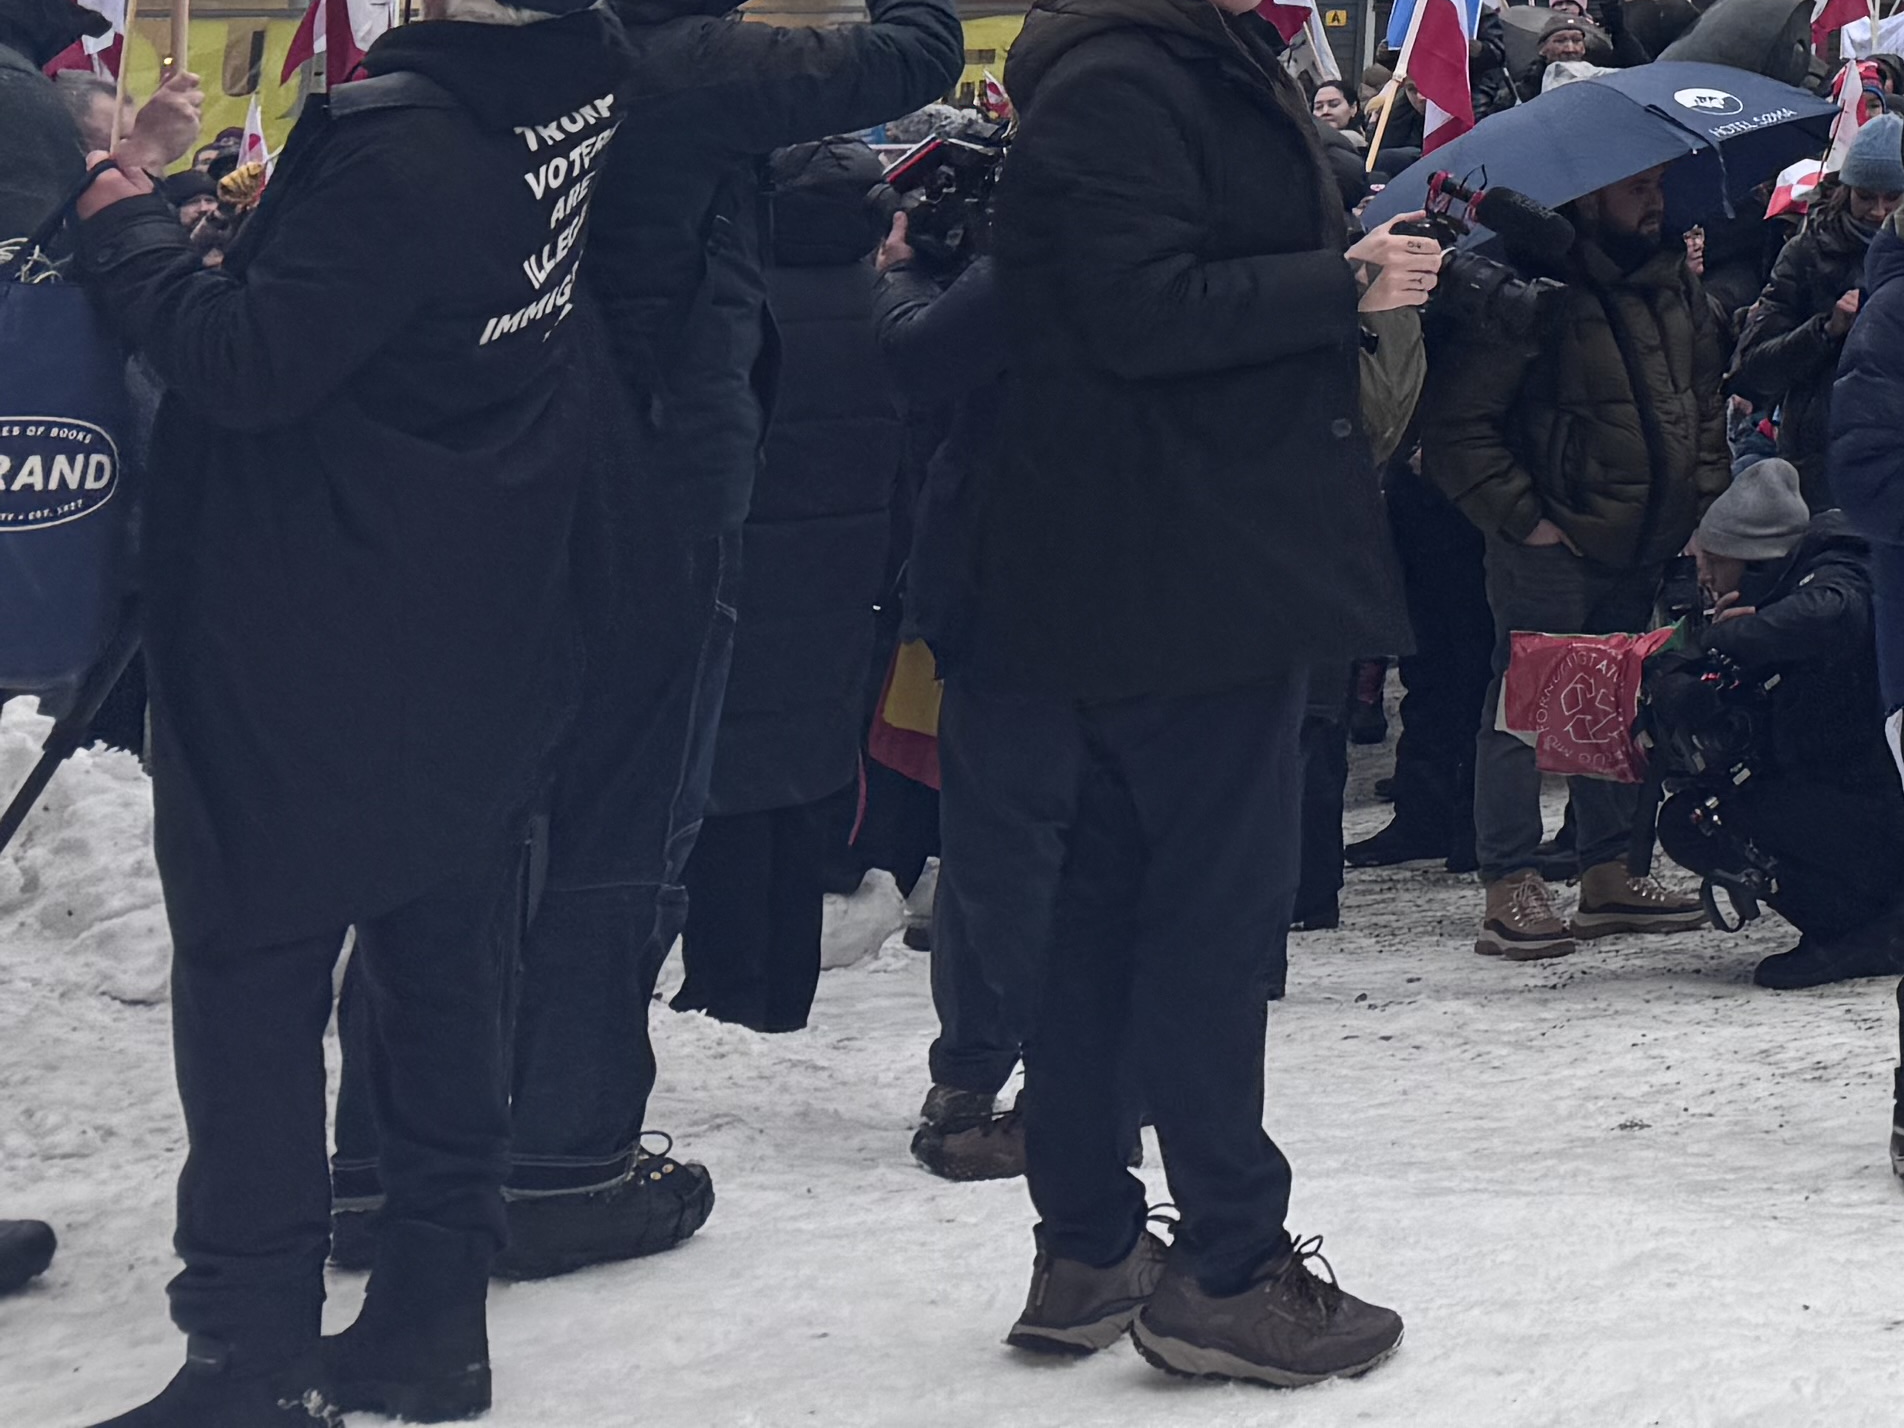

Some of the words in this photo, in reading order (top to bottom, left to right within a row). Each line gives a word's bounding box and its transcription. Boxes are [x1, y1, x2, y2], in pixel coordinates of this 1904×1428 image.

[1709, 119, 1758, 137] HOTEL
[524, 117, 624, 201] VOTER
[550, 171, 595, 229] ARE
[479, 258, 580, 345] IMMIG
[50, 427, 92, 444] BOOKS
